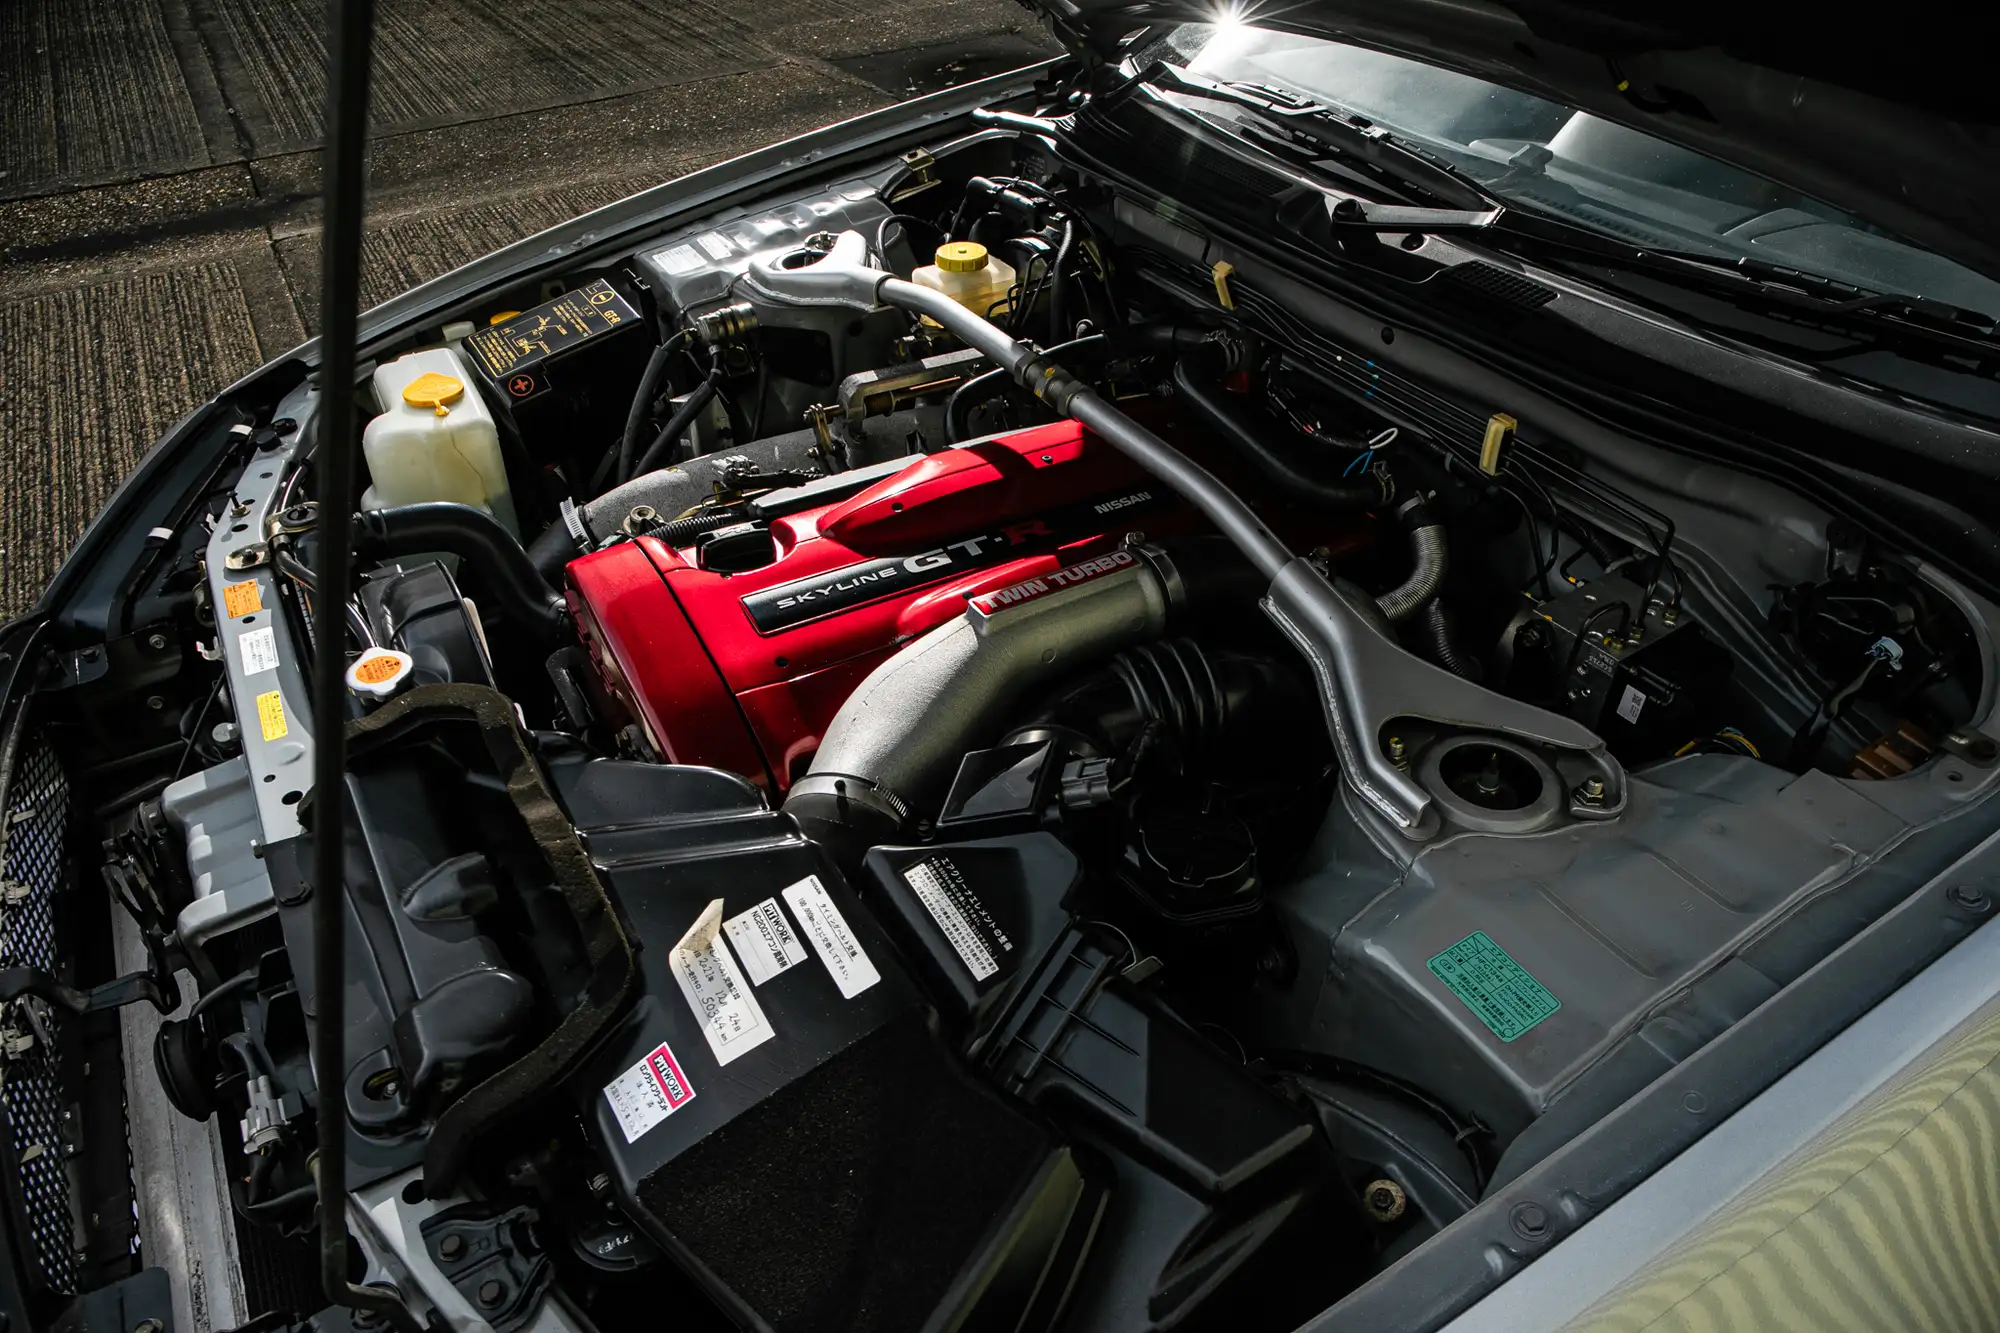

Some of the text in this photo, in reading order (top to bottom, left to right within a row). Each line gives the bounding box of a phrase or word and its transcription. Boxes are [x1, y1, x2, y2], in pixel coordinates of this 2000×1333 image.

[1094, 491, 1152, 514] NISSAN
[776, 566, 898, 610] SKYLINE
[978, 551, 1133, 609] TWIN TURBO
[762, 903, 792, 945] PITWORK
[652, 1053, 685, 1101] PITWORK
